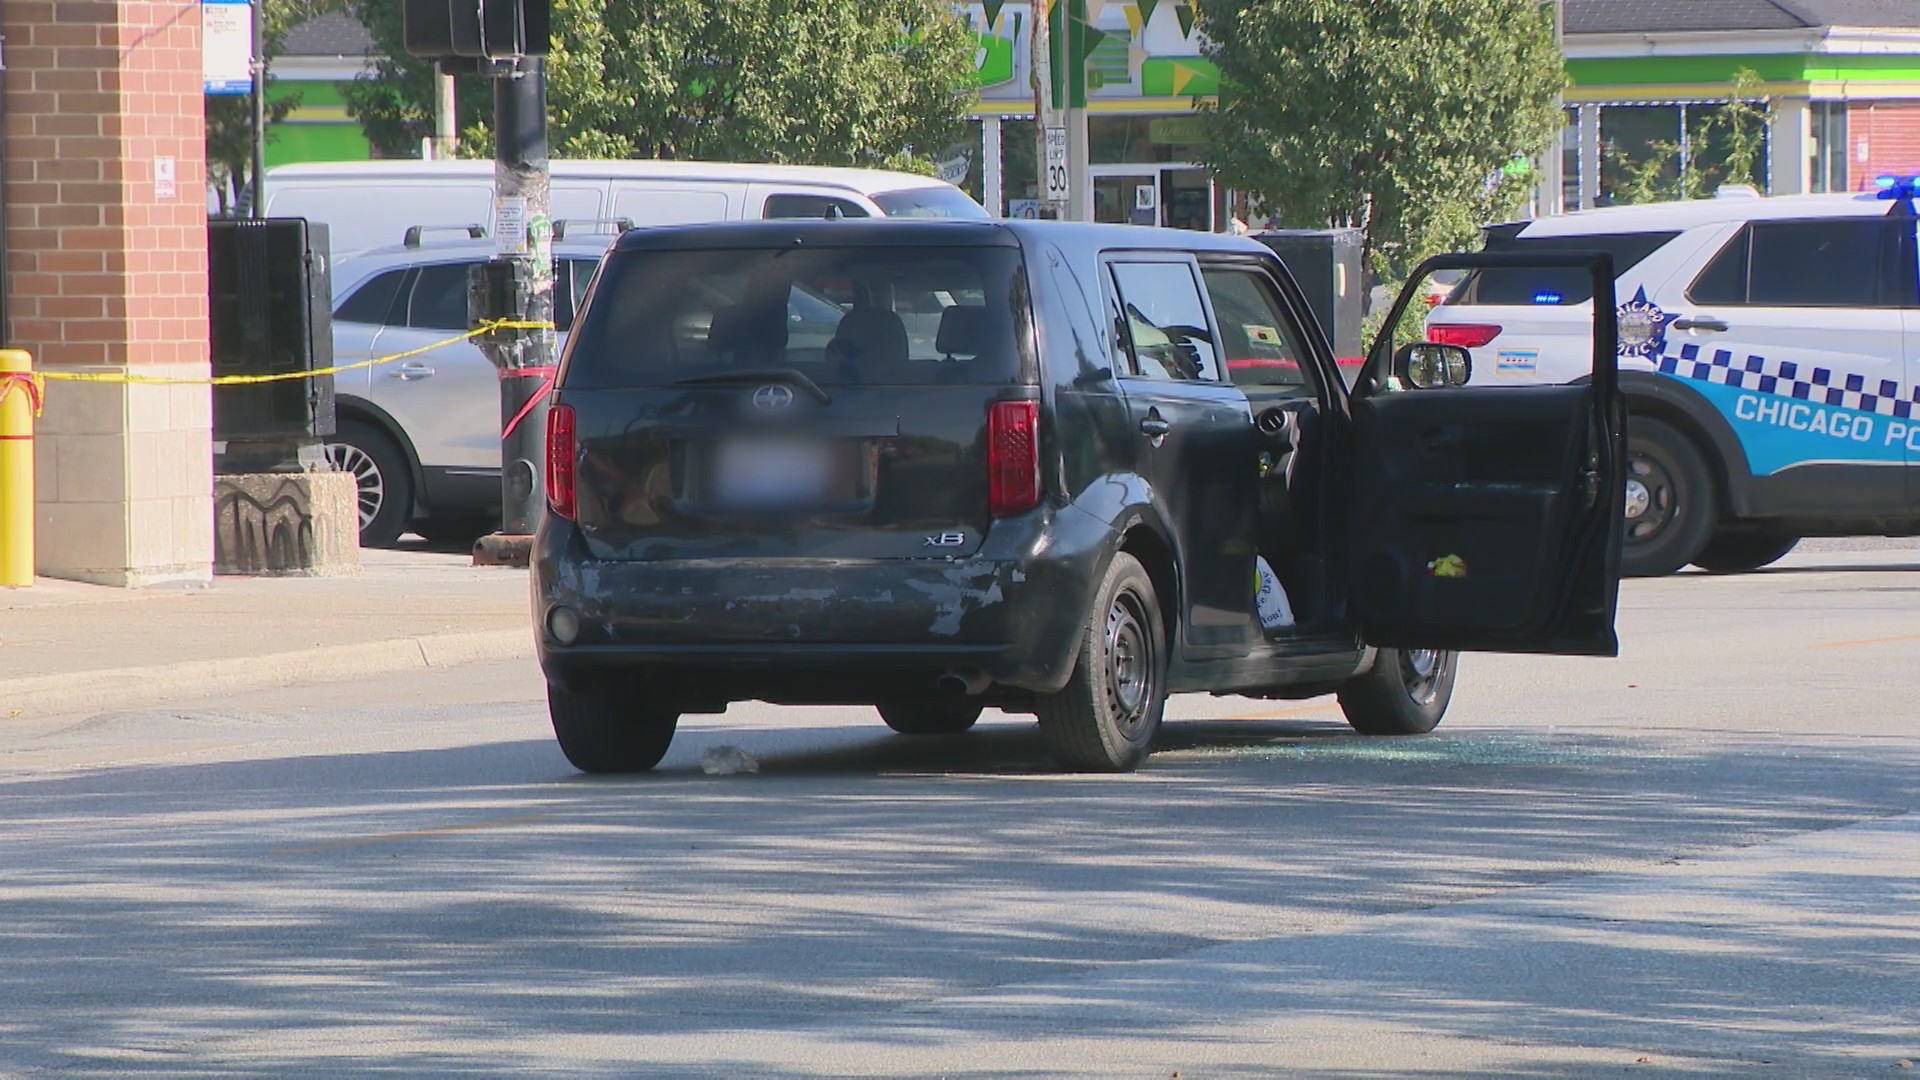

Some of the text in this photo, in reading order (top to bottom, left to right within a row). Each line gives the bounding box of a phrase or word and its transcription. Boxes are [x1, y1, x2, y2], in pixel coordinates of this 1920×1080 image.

[1047, 132, 1065, 146] SPEED
[1049, 165, 1066, 191] 30
[1616, 301, 1665, 323] HICAGO
[1617, 337, 1660, 357] OLICE
[1734, 393, 1874, 442] CHICAGO
[923, 532, 964, 546] xB
